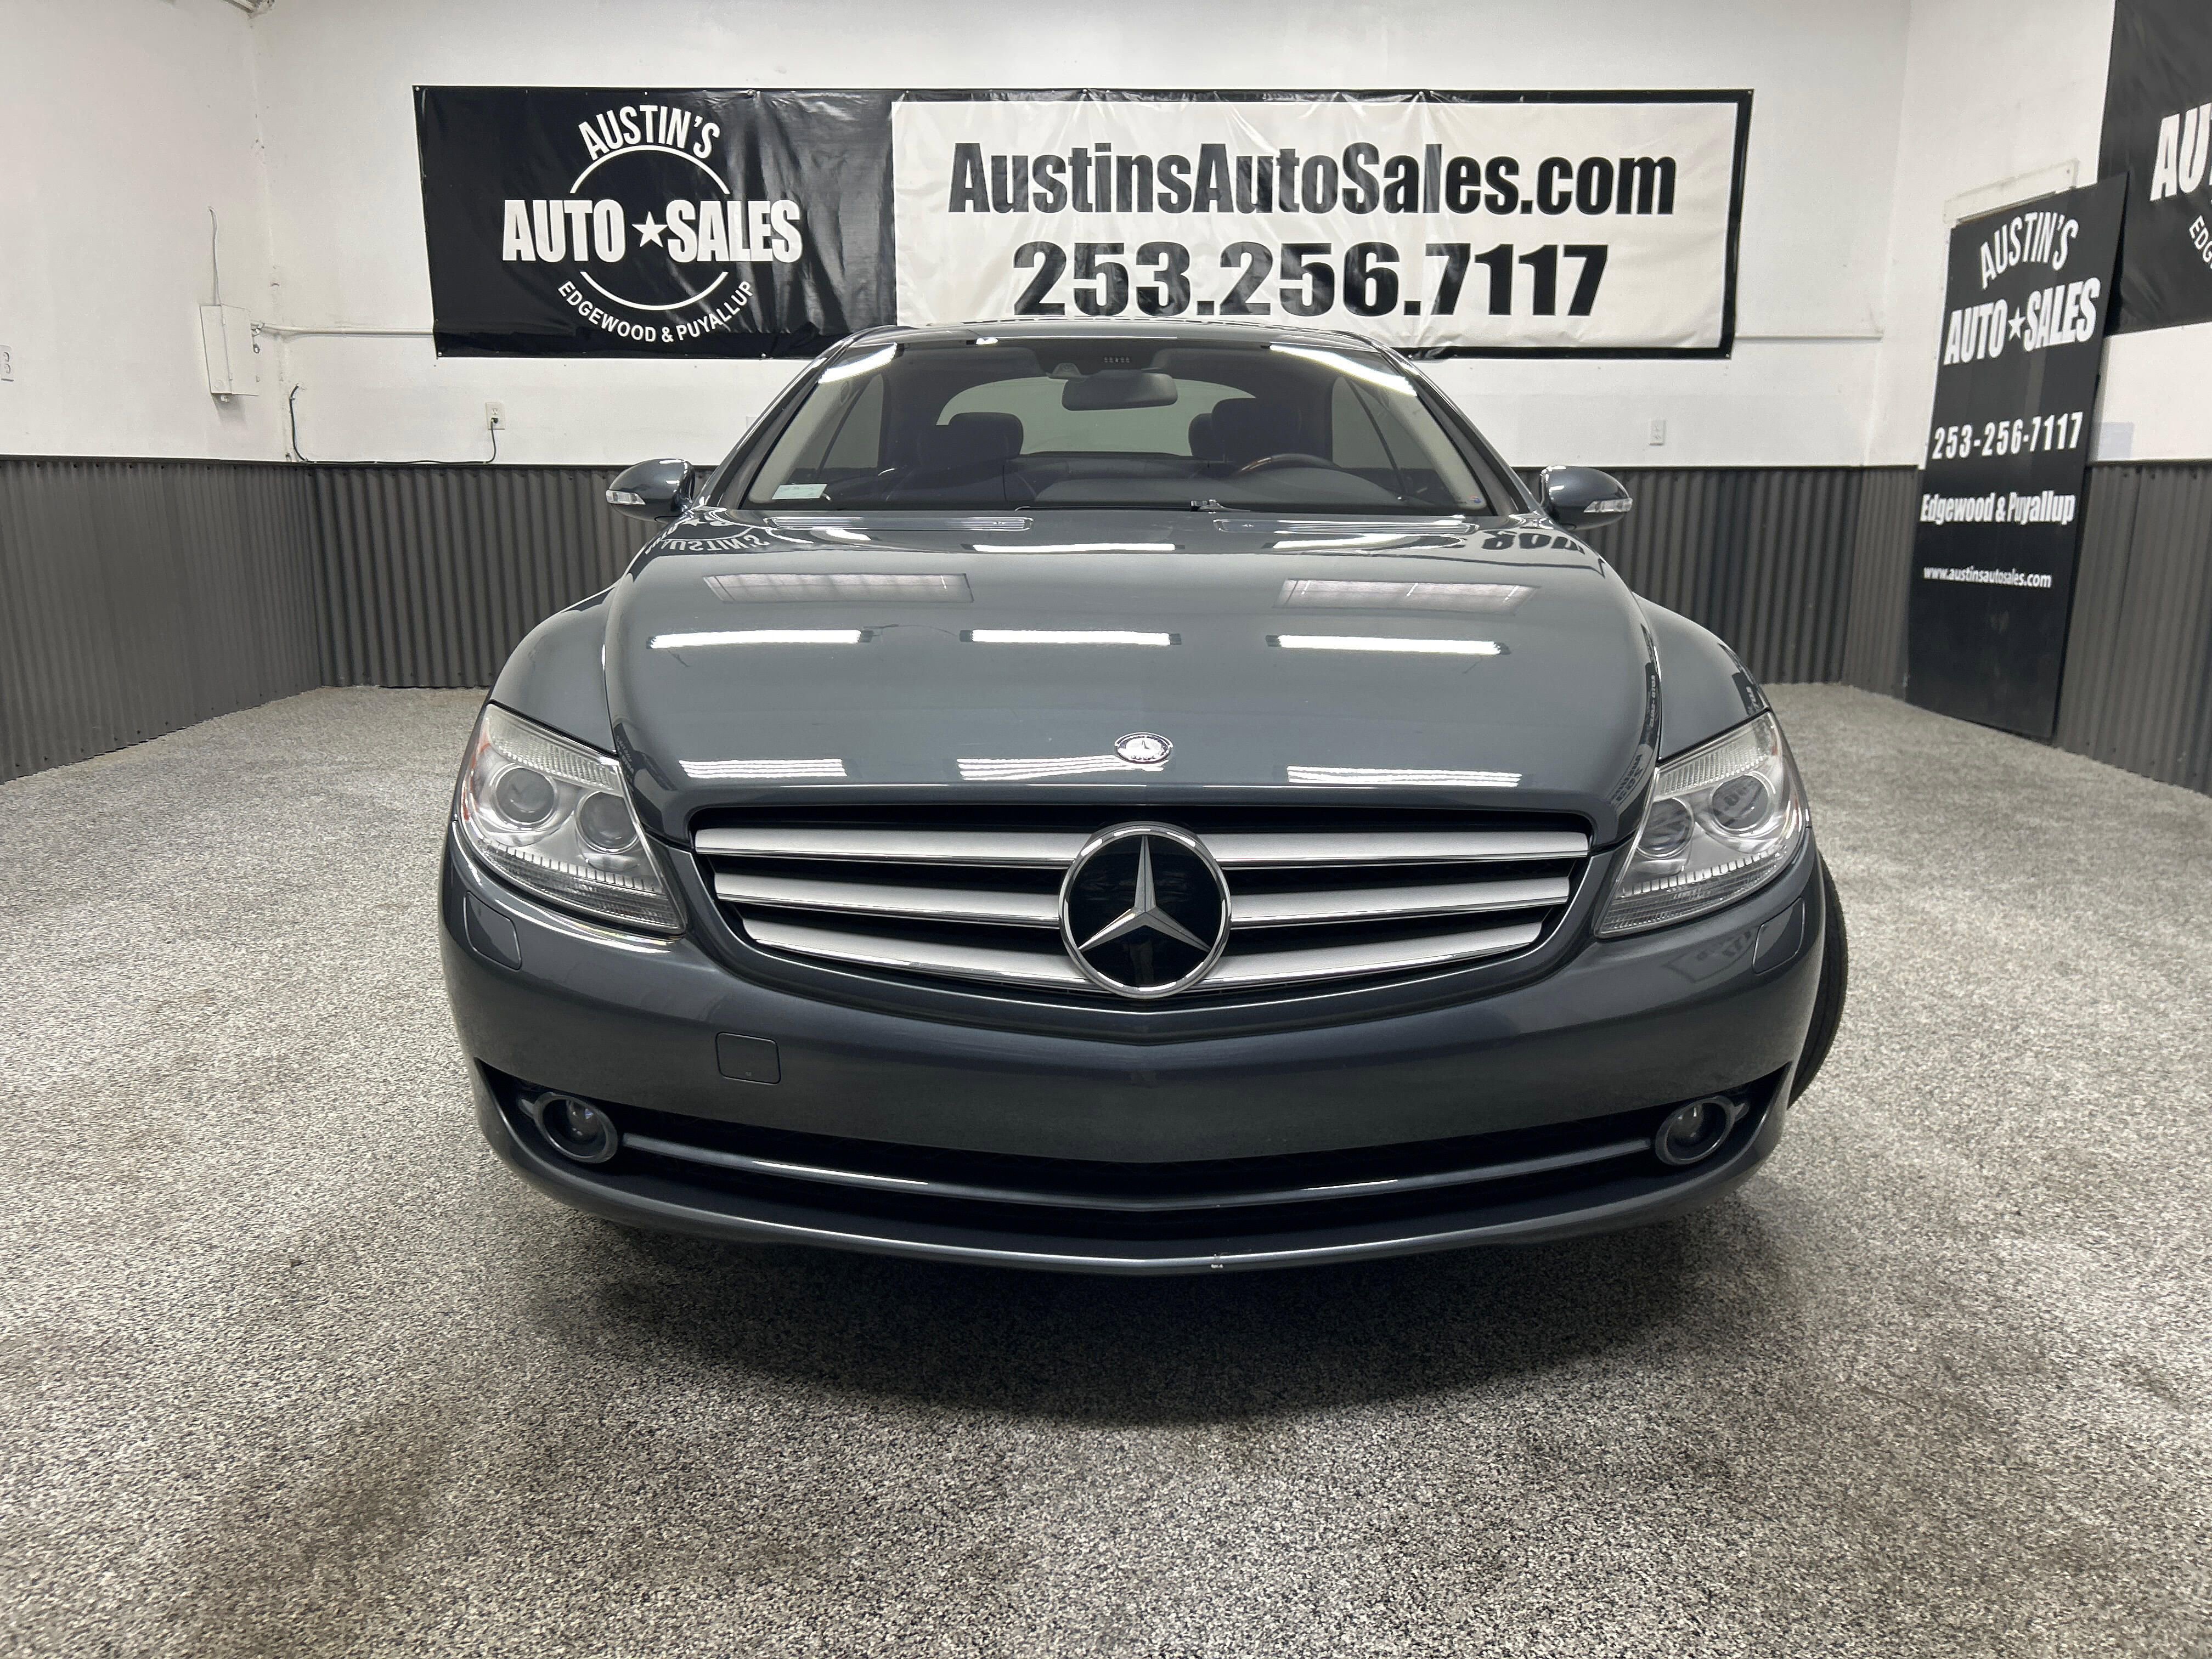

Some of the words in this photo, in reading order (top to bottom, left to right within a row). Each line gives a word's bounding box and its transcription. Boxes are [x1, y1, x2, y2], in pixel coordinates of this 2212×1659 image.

[578, 104, 720, 160] AUSTIN'S
[2149, 102, 2212, 201] AU
[947, 142, 1675, 216] AustinsAutoSales.com
[502, 199, 625, 263] AUTO
[666, 199, 803, 263] SALES
[1979, 211, 2079, 290] AUSTIN'S
[1012, 240, 1608, 317] 253.256.7117
[558, 280, 657, 342] EDGEWOOD
[662, 329, 674, 342] &
[676, 280, 754, 341] PUYALLUP
[1943, 298, 2008, 365] AUTO
[2024, 277, 2101, 352] SALES
[1931, 411, 2083, 460] 253-256-7117
[1920, 492, 1996, 526] Edgewood
[1995, 497, 2006, 523] &
[2007, 490, 2076, 526] Puyallup
[1923, 565, 2052, 589] www.austinsautosales.com
